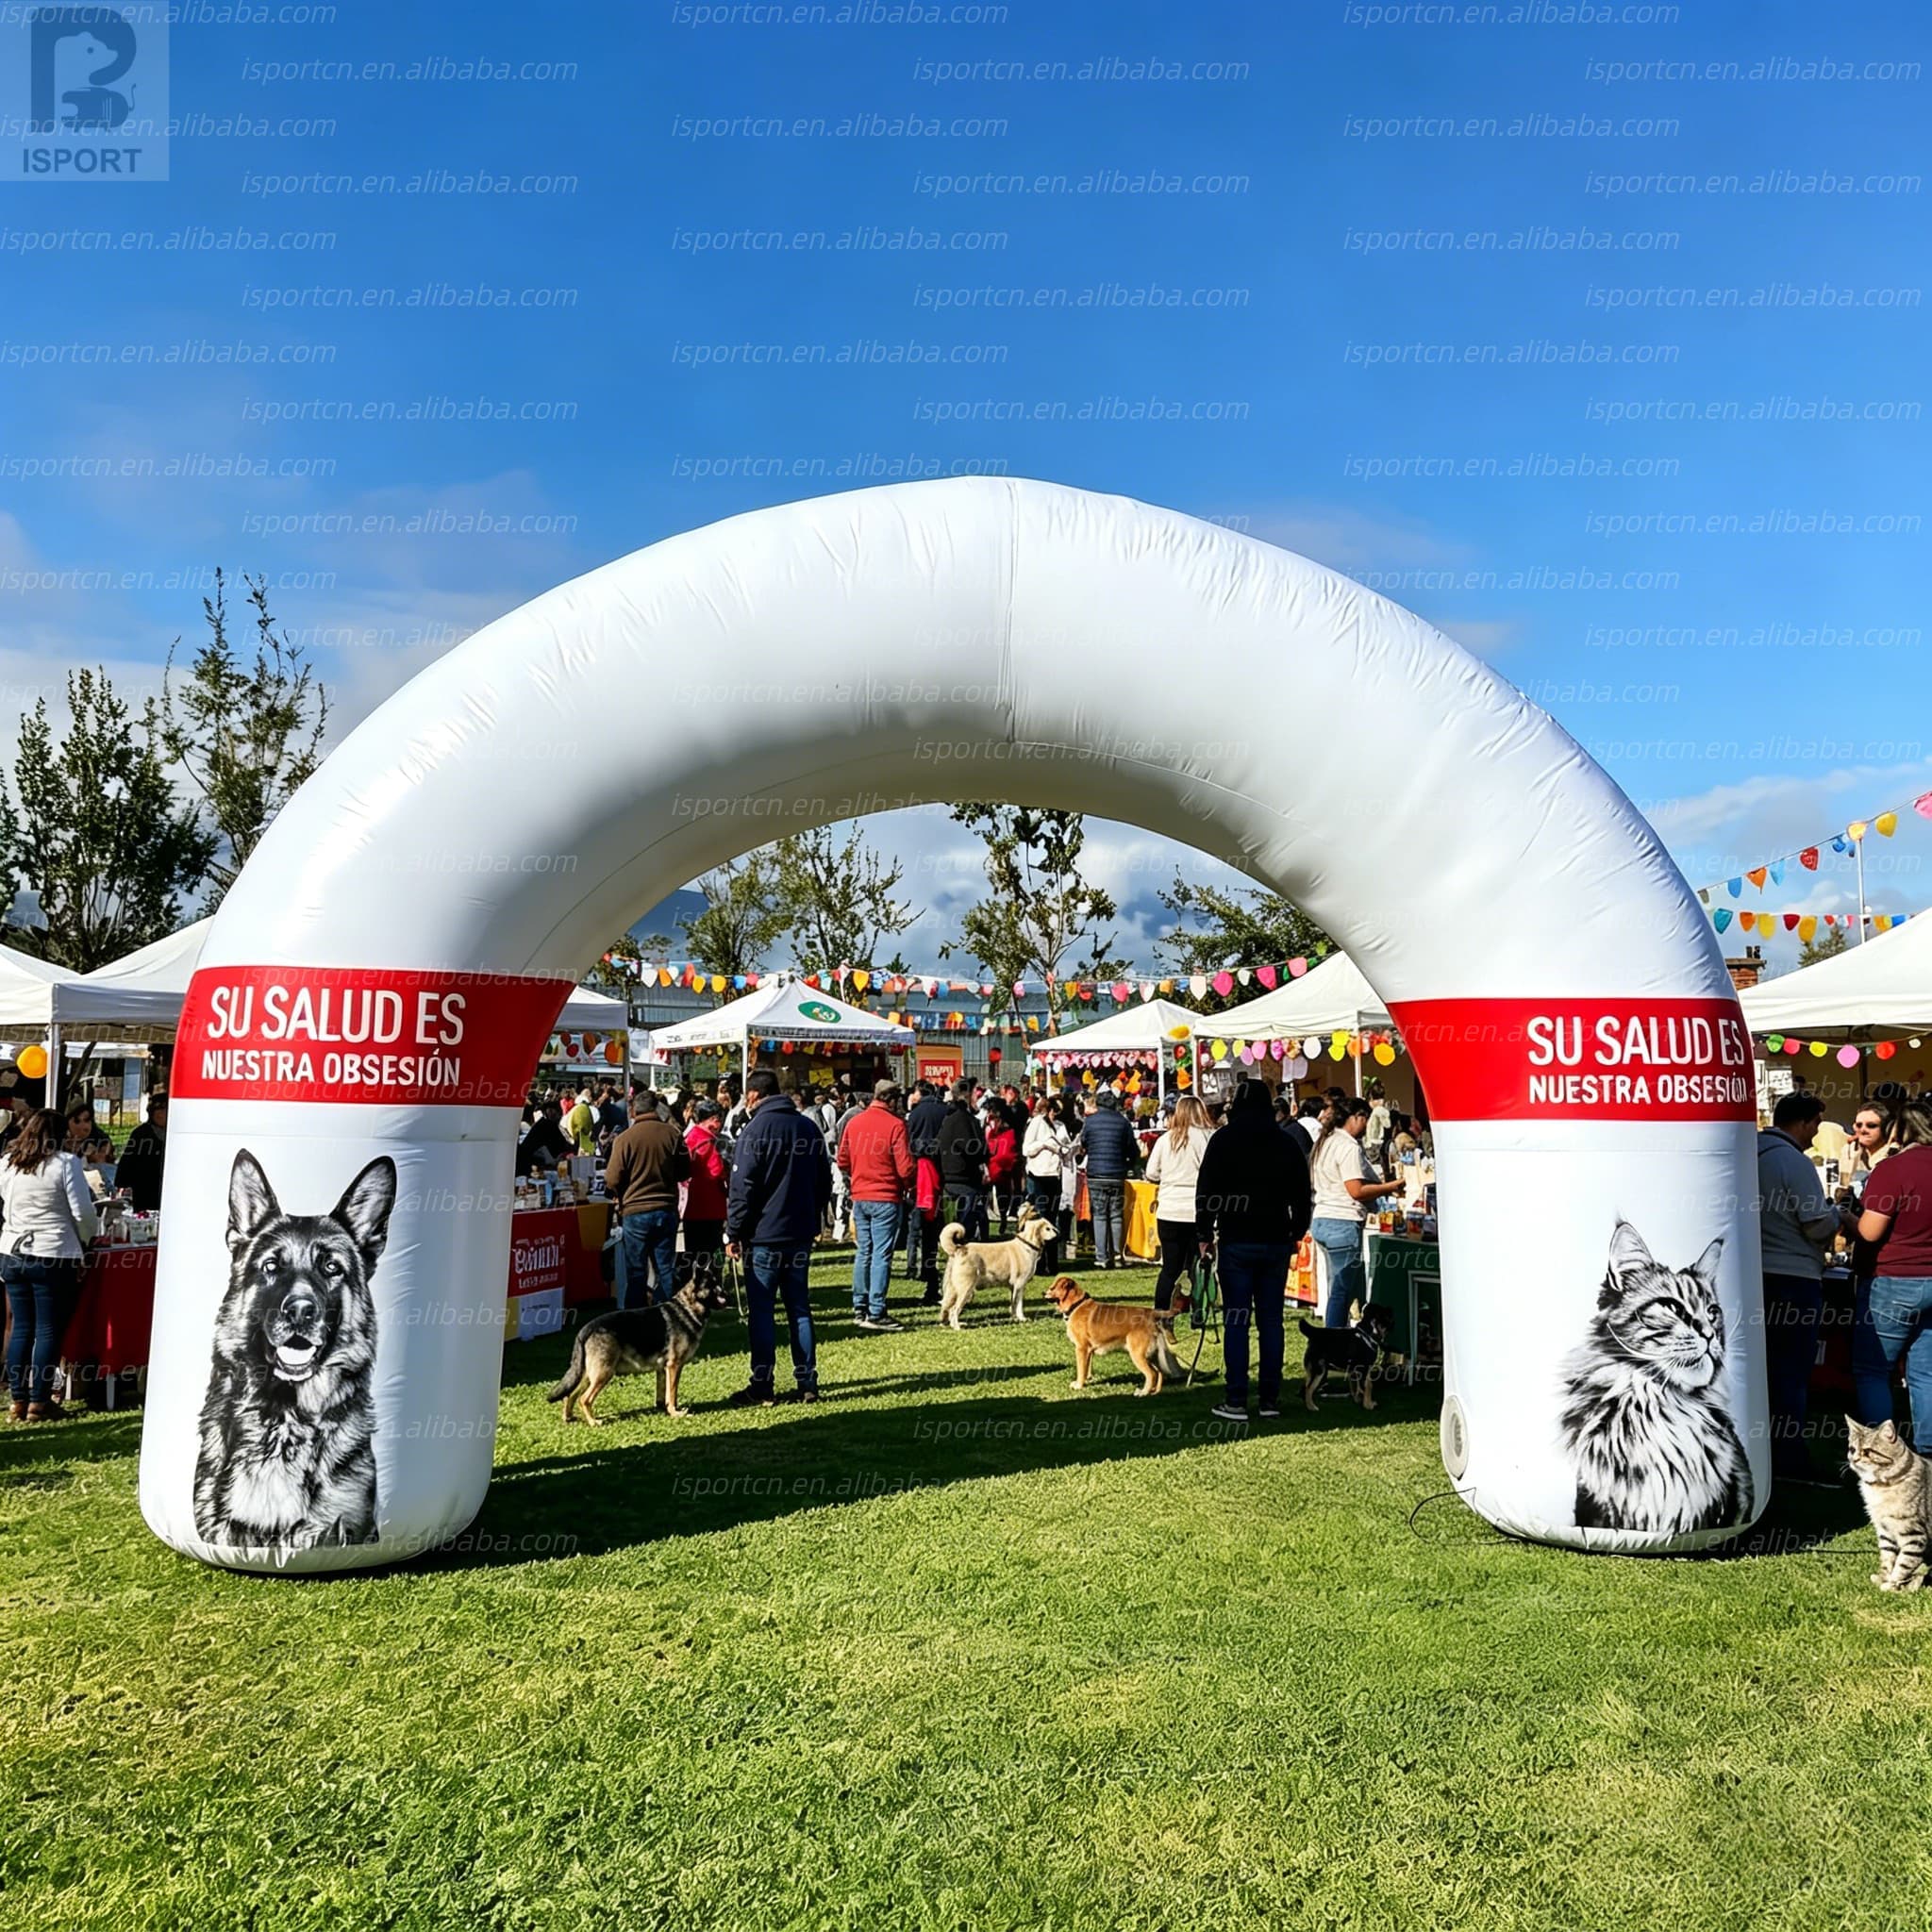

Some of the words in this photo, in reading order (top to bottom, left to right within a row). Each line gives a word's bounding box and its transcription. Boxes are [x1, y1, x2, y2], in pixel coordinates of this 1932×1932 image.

[207, 986, 255, 1039] SU
[260, 985, 404, 1044] SALUD
[415, 991, 466, 1046] ES
[1526, 1016, 1582, 1066] SU
[1594, 1015, 1713, 1066] SALUD
[1718, 1019, 1745, 1066] ES
[201, 1050, 314, 1082] NUESTRA
[324, 1048, 461, 1087] OBSESIÓN
[1529, 1074, 1652, 1105] NUESTRA
